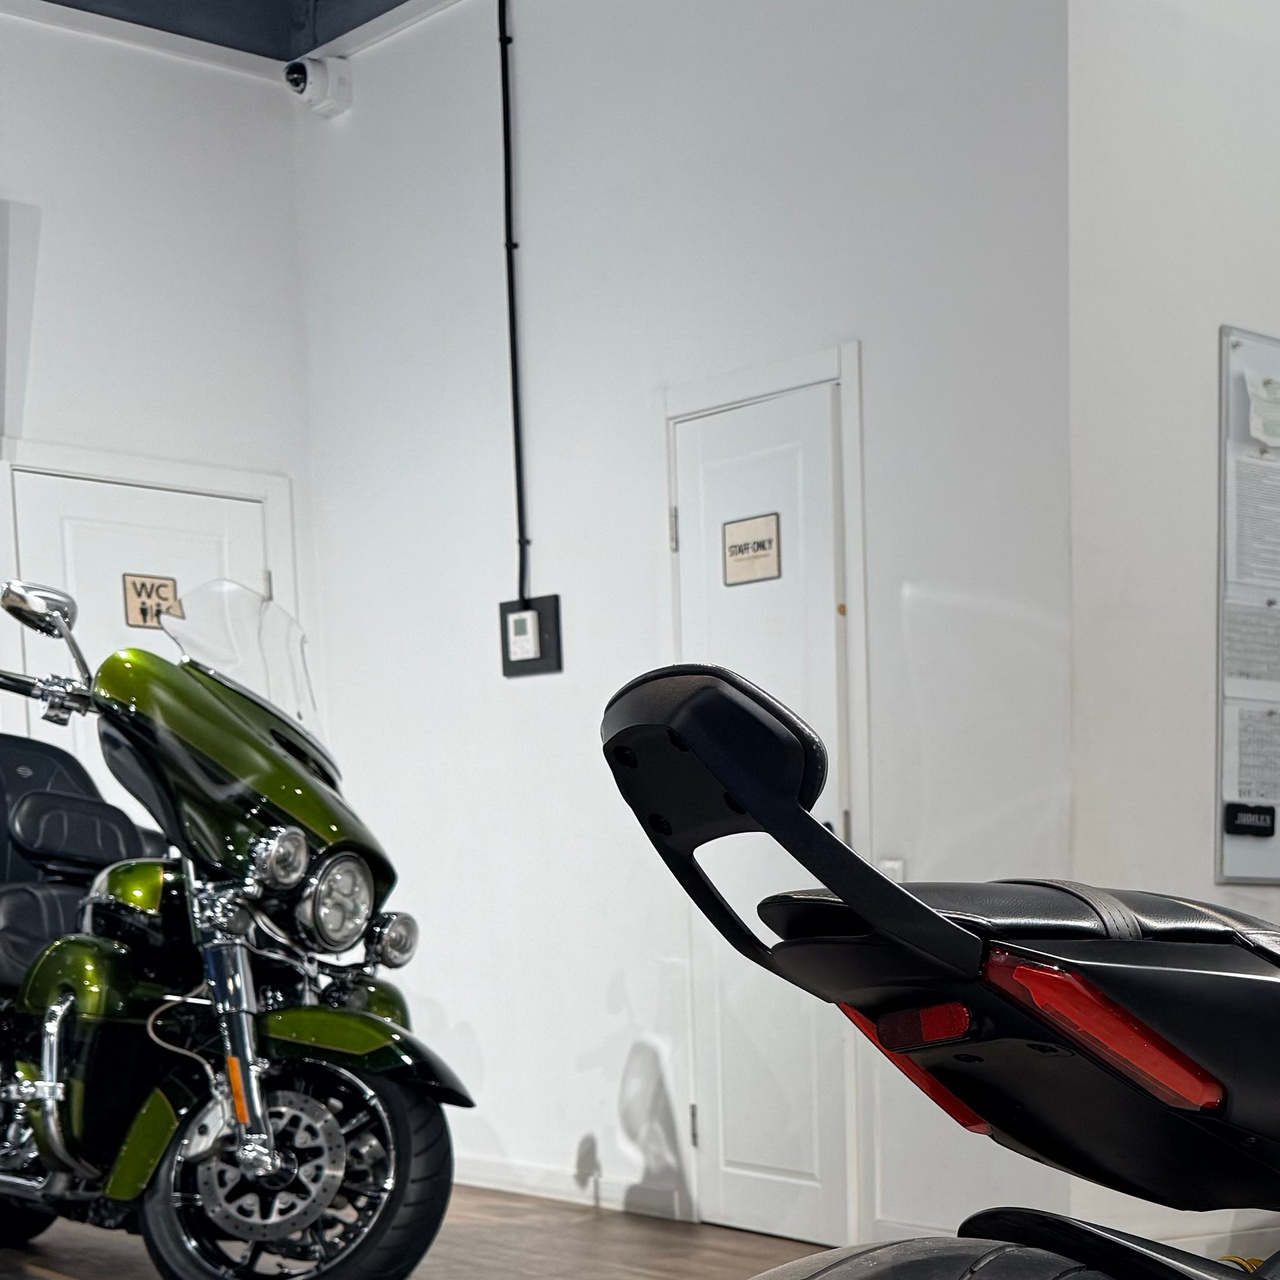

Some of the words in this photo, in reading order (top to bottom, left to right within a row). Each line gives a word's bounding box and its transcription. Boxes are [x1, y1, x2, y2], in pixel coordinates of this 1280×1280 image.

[728, 542, 751, 557] STAFF
[752, 538, 774, 553] ONLY
[131, 580, 169, 601] WC
